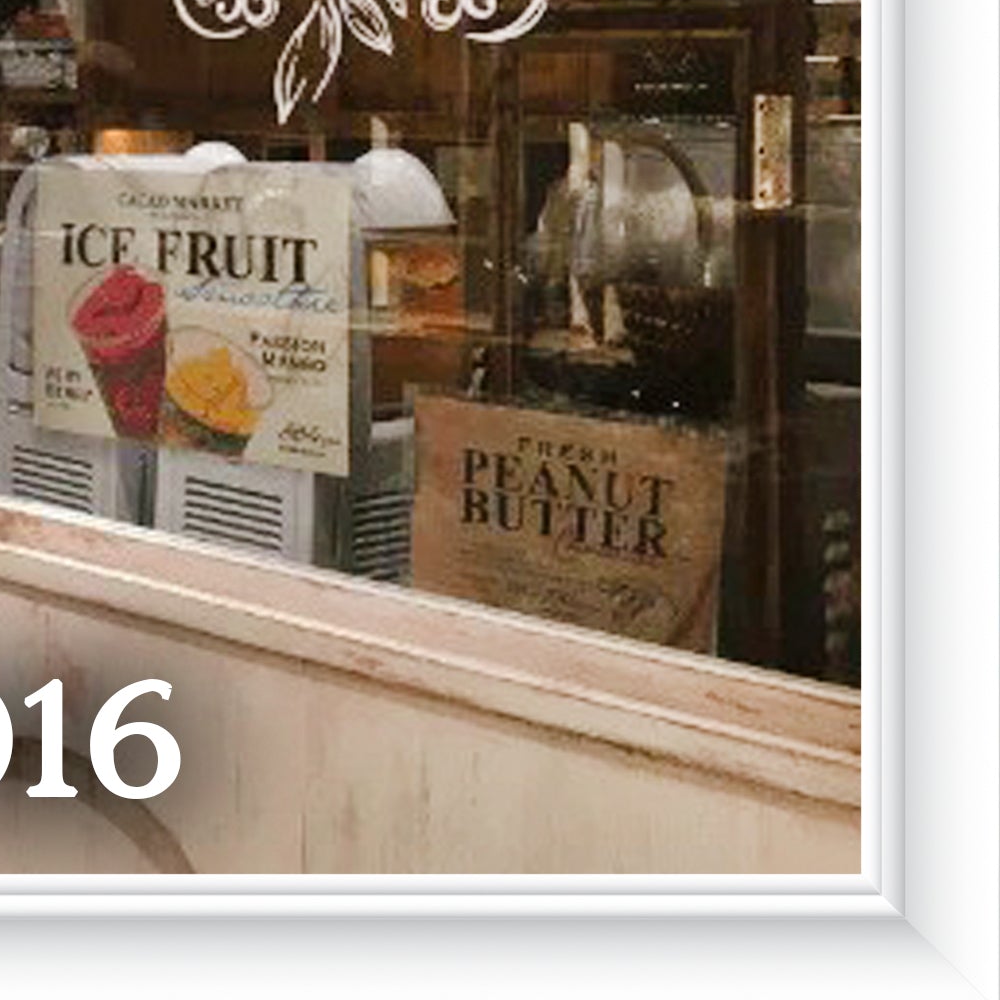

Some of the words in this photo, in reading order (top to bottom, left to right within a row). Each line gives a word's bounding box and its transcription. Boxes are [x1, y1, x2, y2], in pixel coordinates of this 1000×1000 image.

[118, 192, 170, 209] CACAO
[60, 222, 137, 268] ICE
[155, 229, 319, 284] FRUIT
[460, 448, 676, 516] PEANUT
[460, 487, 669, 558] BUTTER
